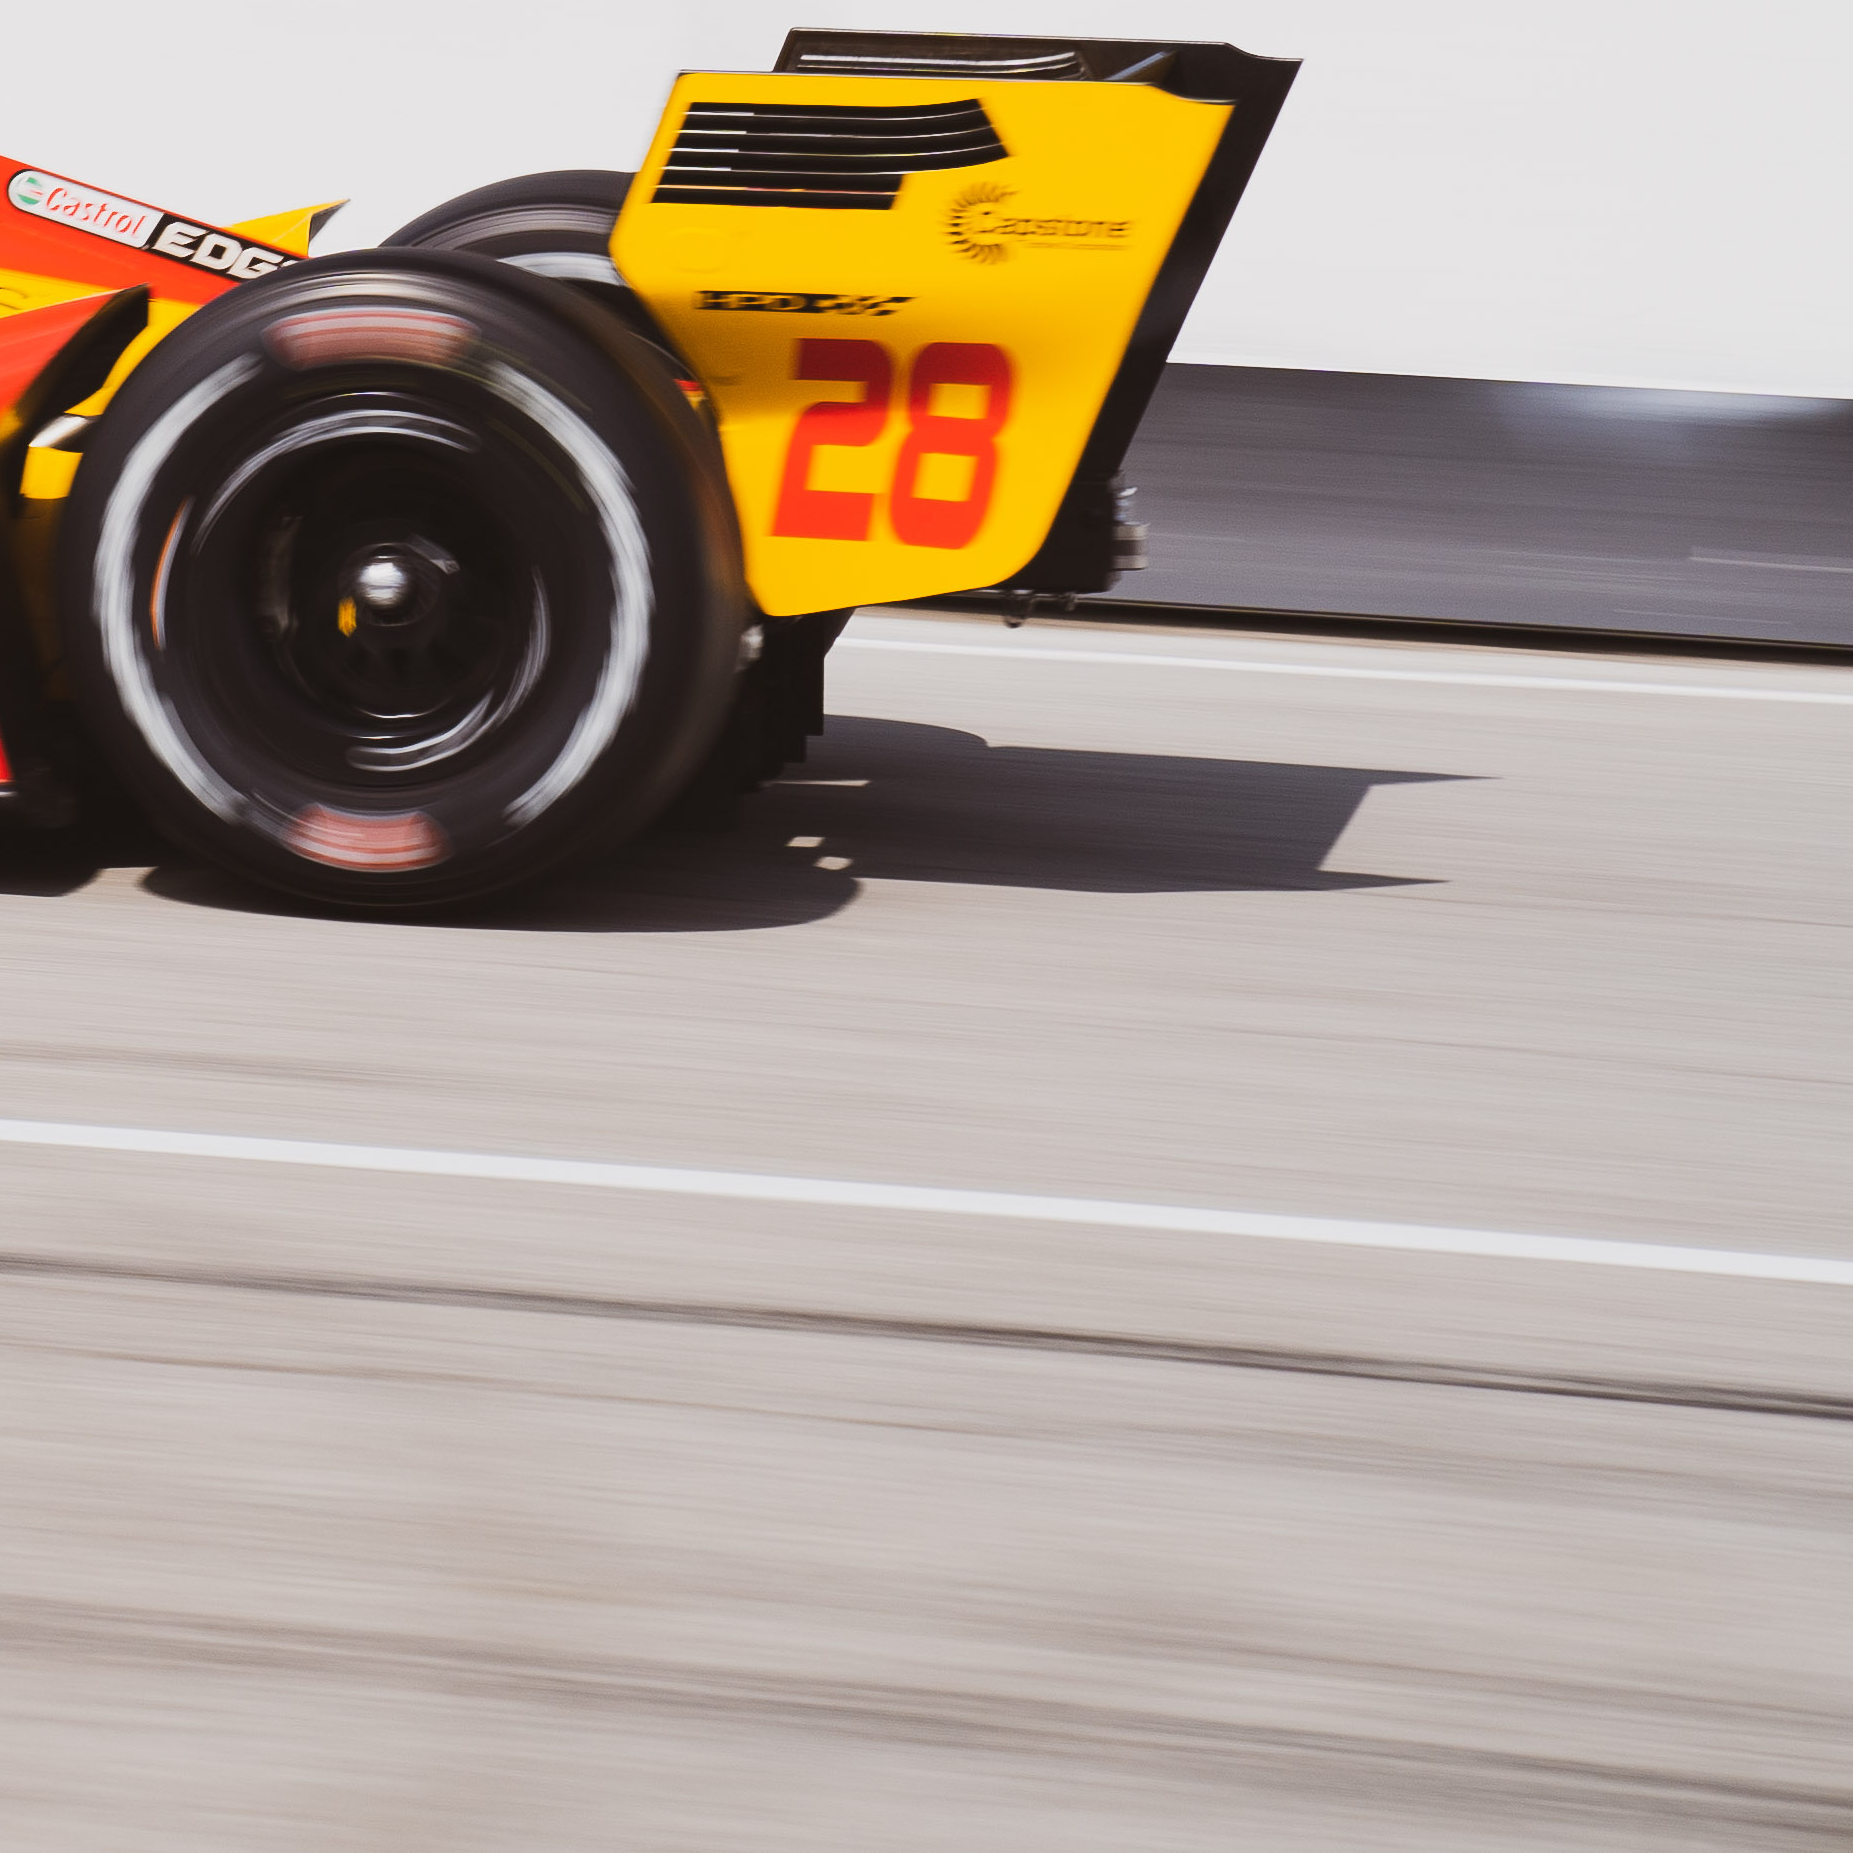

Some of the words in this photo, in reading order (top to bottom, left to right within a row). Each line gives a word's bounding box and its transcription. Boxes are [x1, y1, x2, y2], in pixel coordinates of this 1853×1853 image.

[46, 187, 147, 239] Castrol
[152, 220, 299, 279] EDG
[769, 337, 1014, 550] 28
